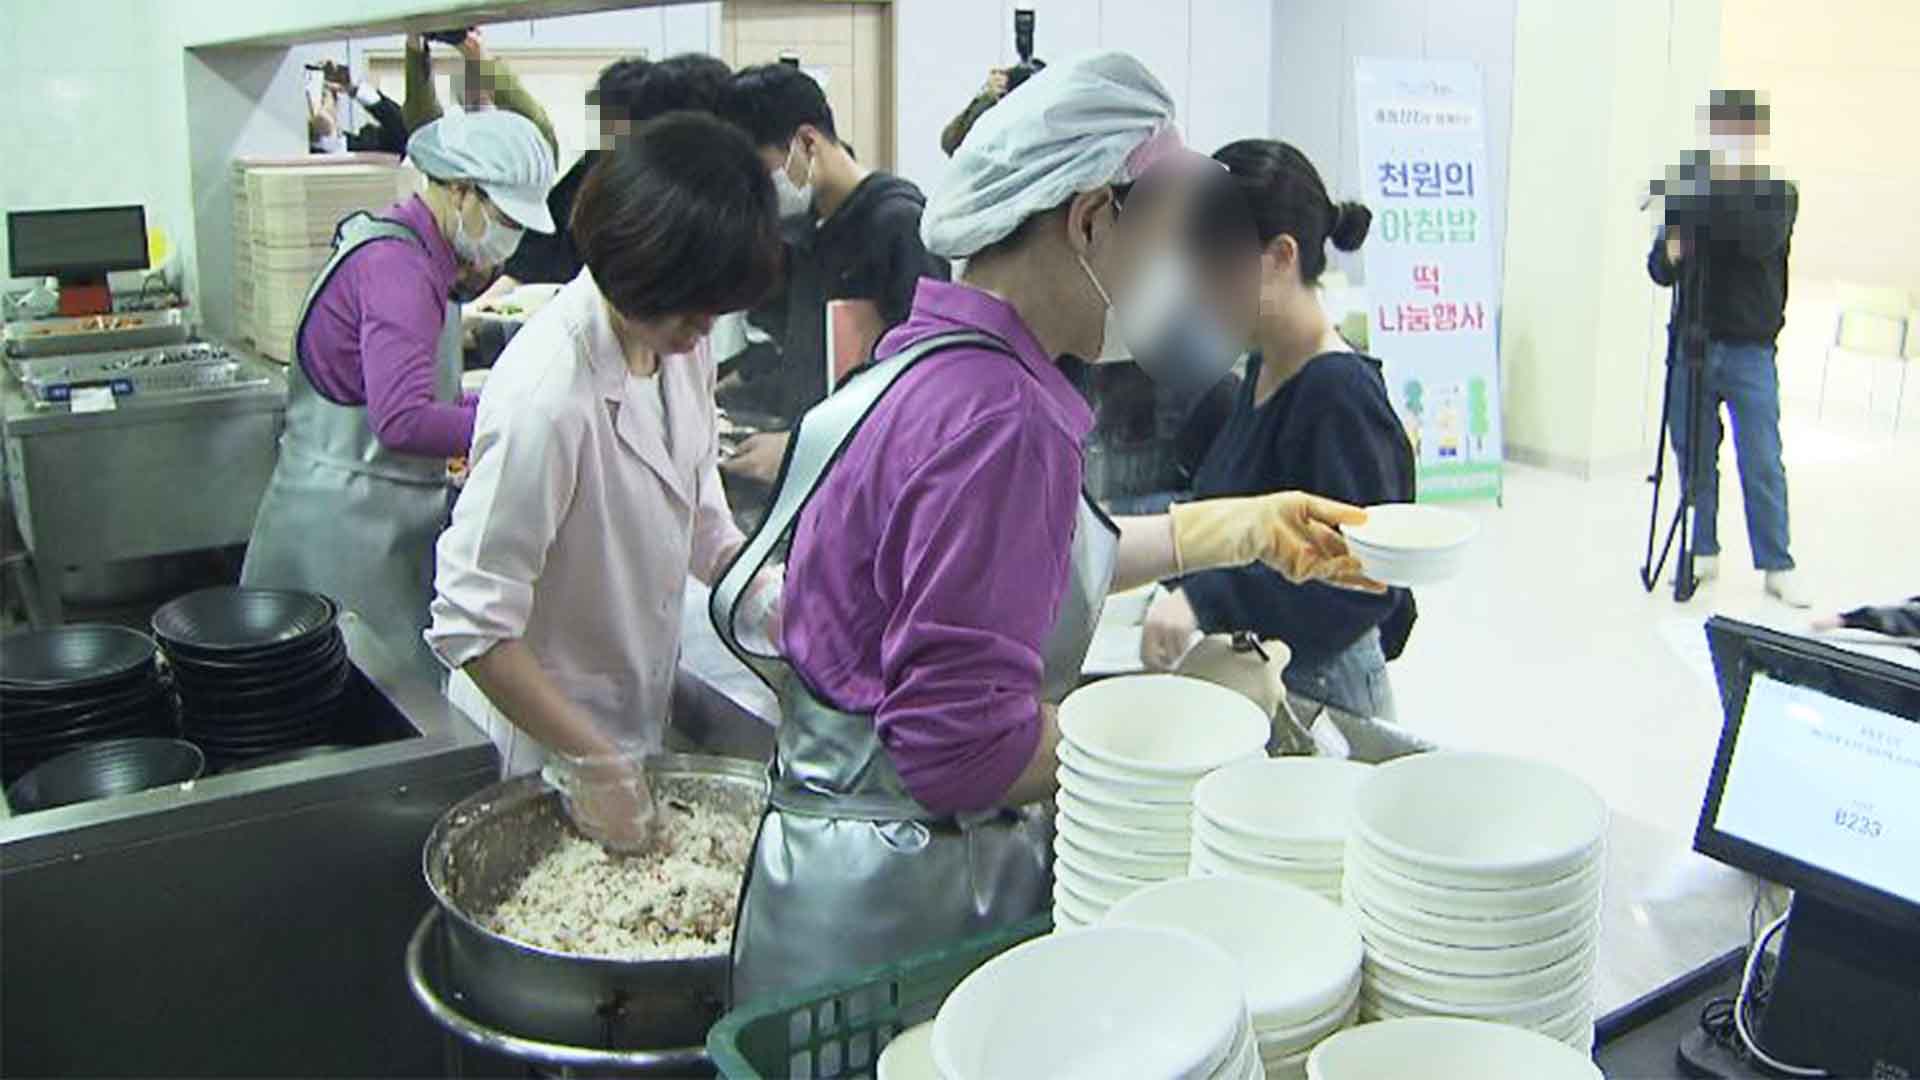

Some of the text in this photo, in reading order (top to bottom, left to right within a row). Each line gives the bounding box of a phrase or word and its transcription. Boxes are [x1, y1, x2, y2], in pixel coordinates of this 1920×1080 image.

[1378, 161, 1474, 198] 천원의
[1380, 208, 1478, 243] 아침밥
[1413, 264, 1440, 295] 떡
[1378, 302, 1485, 332] 나눔행사
